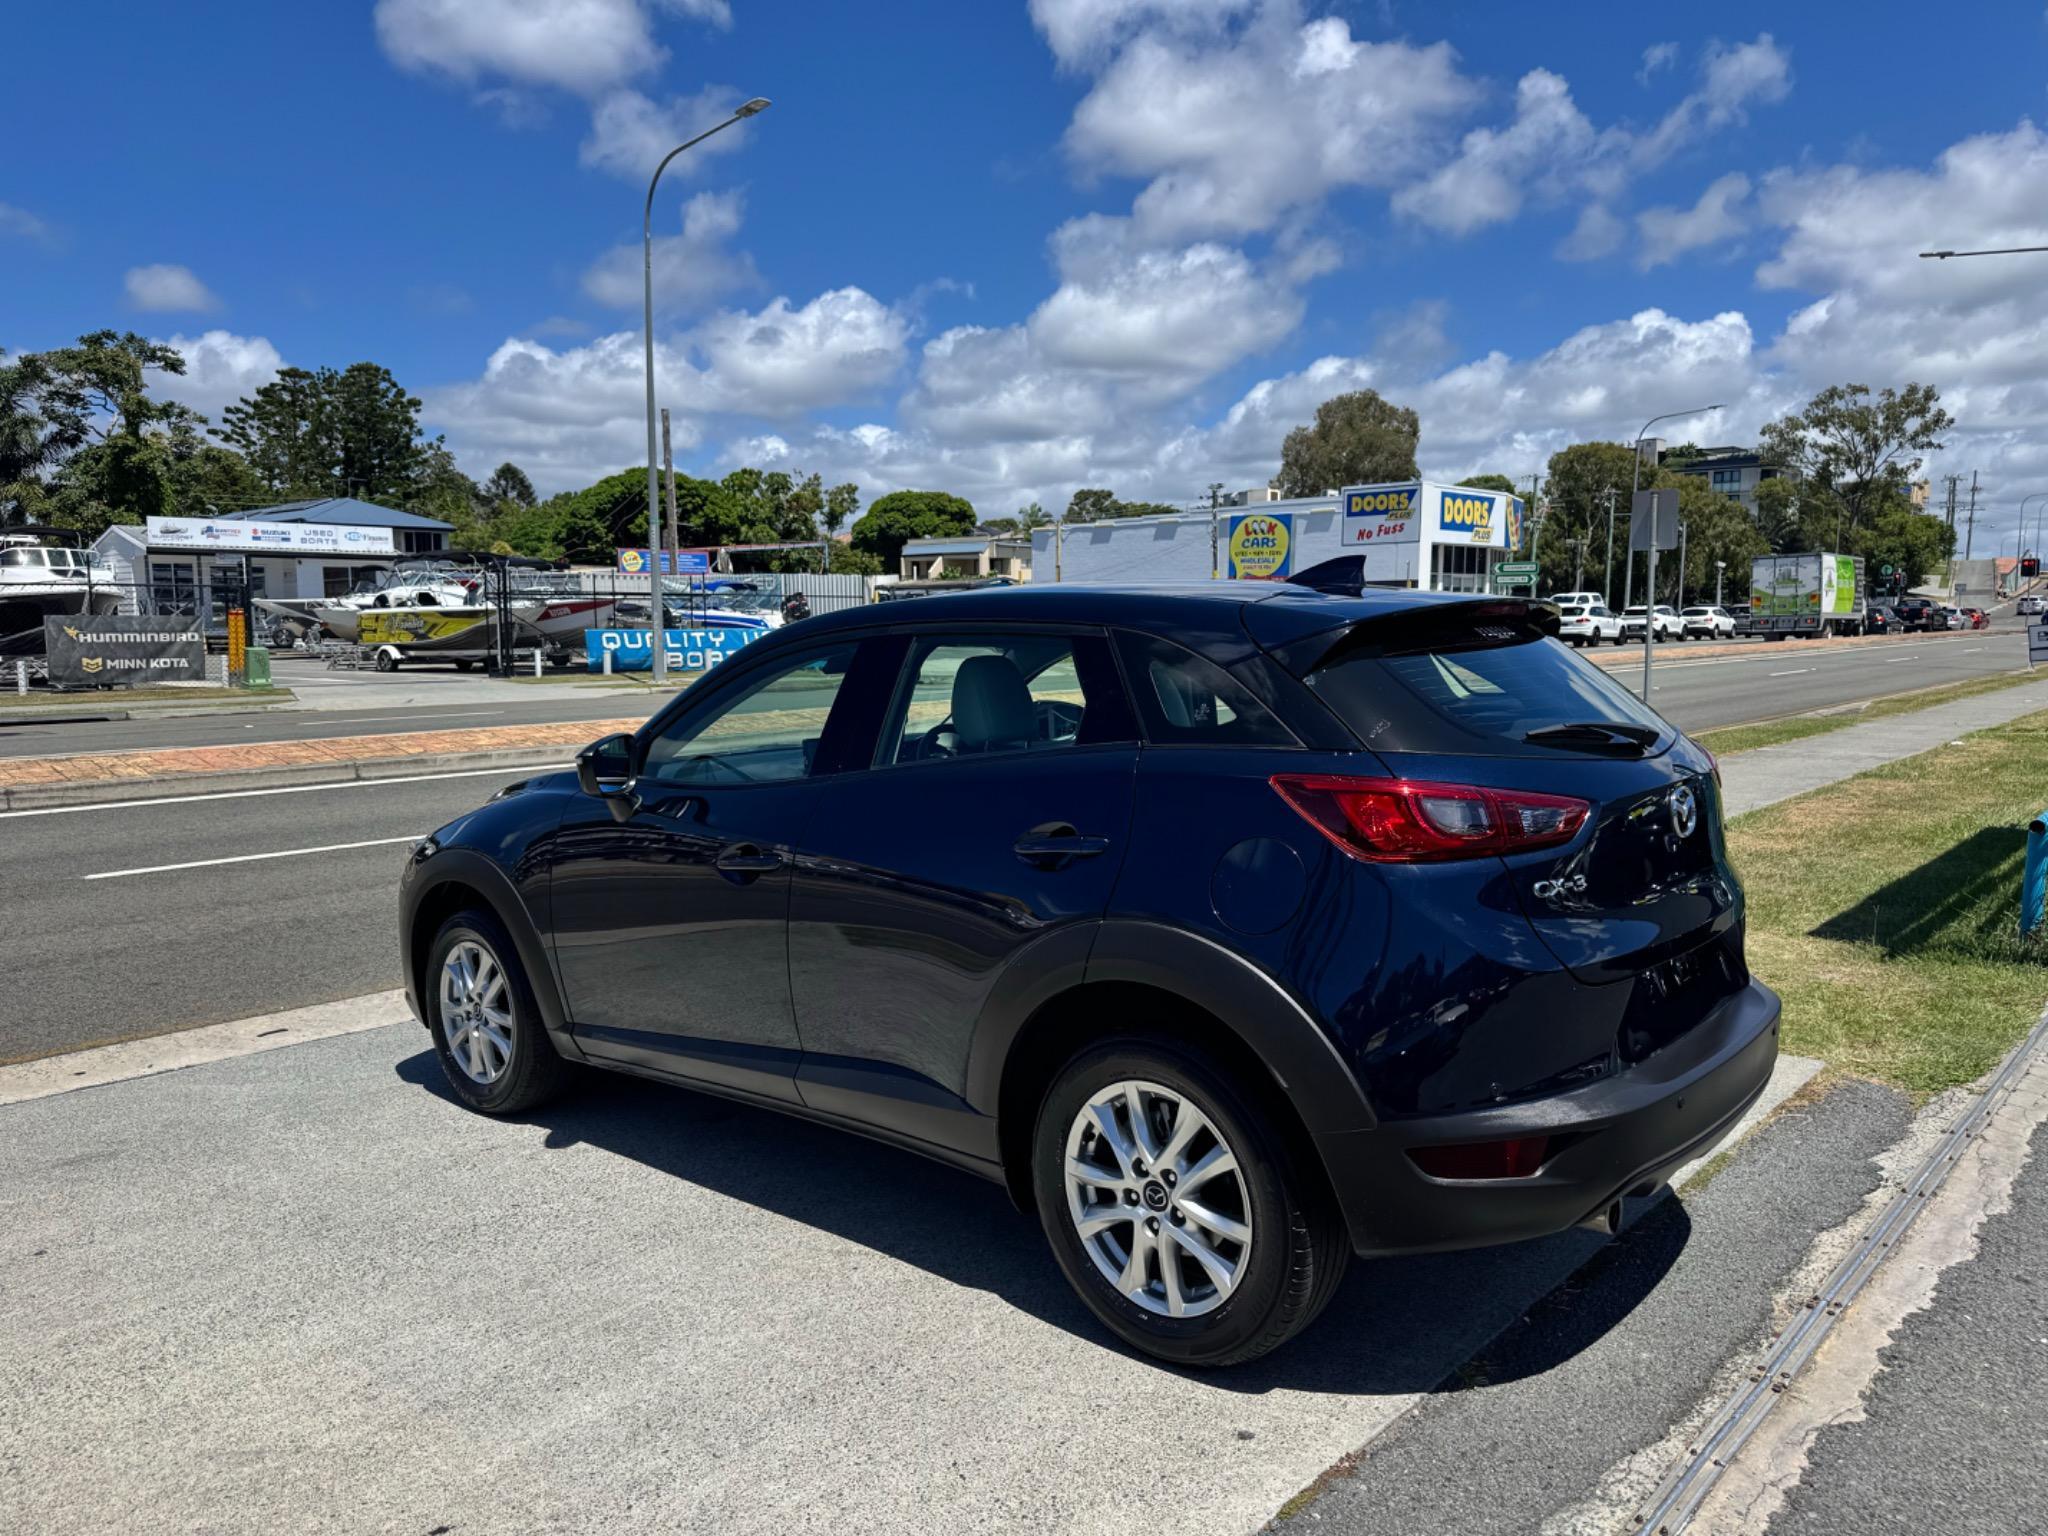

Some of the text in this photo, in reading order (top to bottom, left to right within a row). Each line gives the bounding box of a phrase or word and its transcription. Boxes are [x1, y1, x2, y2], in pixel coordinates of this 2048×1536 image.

[1351, 492, 1409, 513] DOORS
[1444, 496, 1489, 526] DOORS
[303, 528, 334, 537] USED
[1244, 519, 1278, 536] LOOK
[1241, 537, 1277, 549] CARS
[106, 657, 190, 669] MINN KOTA
[1533, 874, 1588, 898] CX-3
